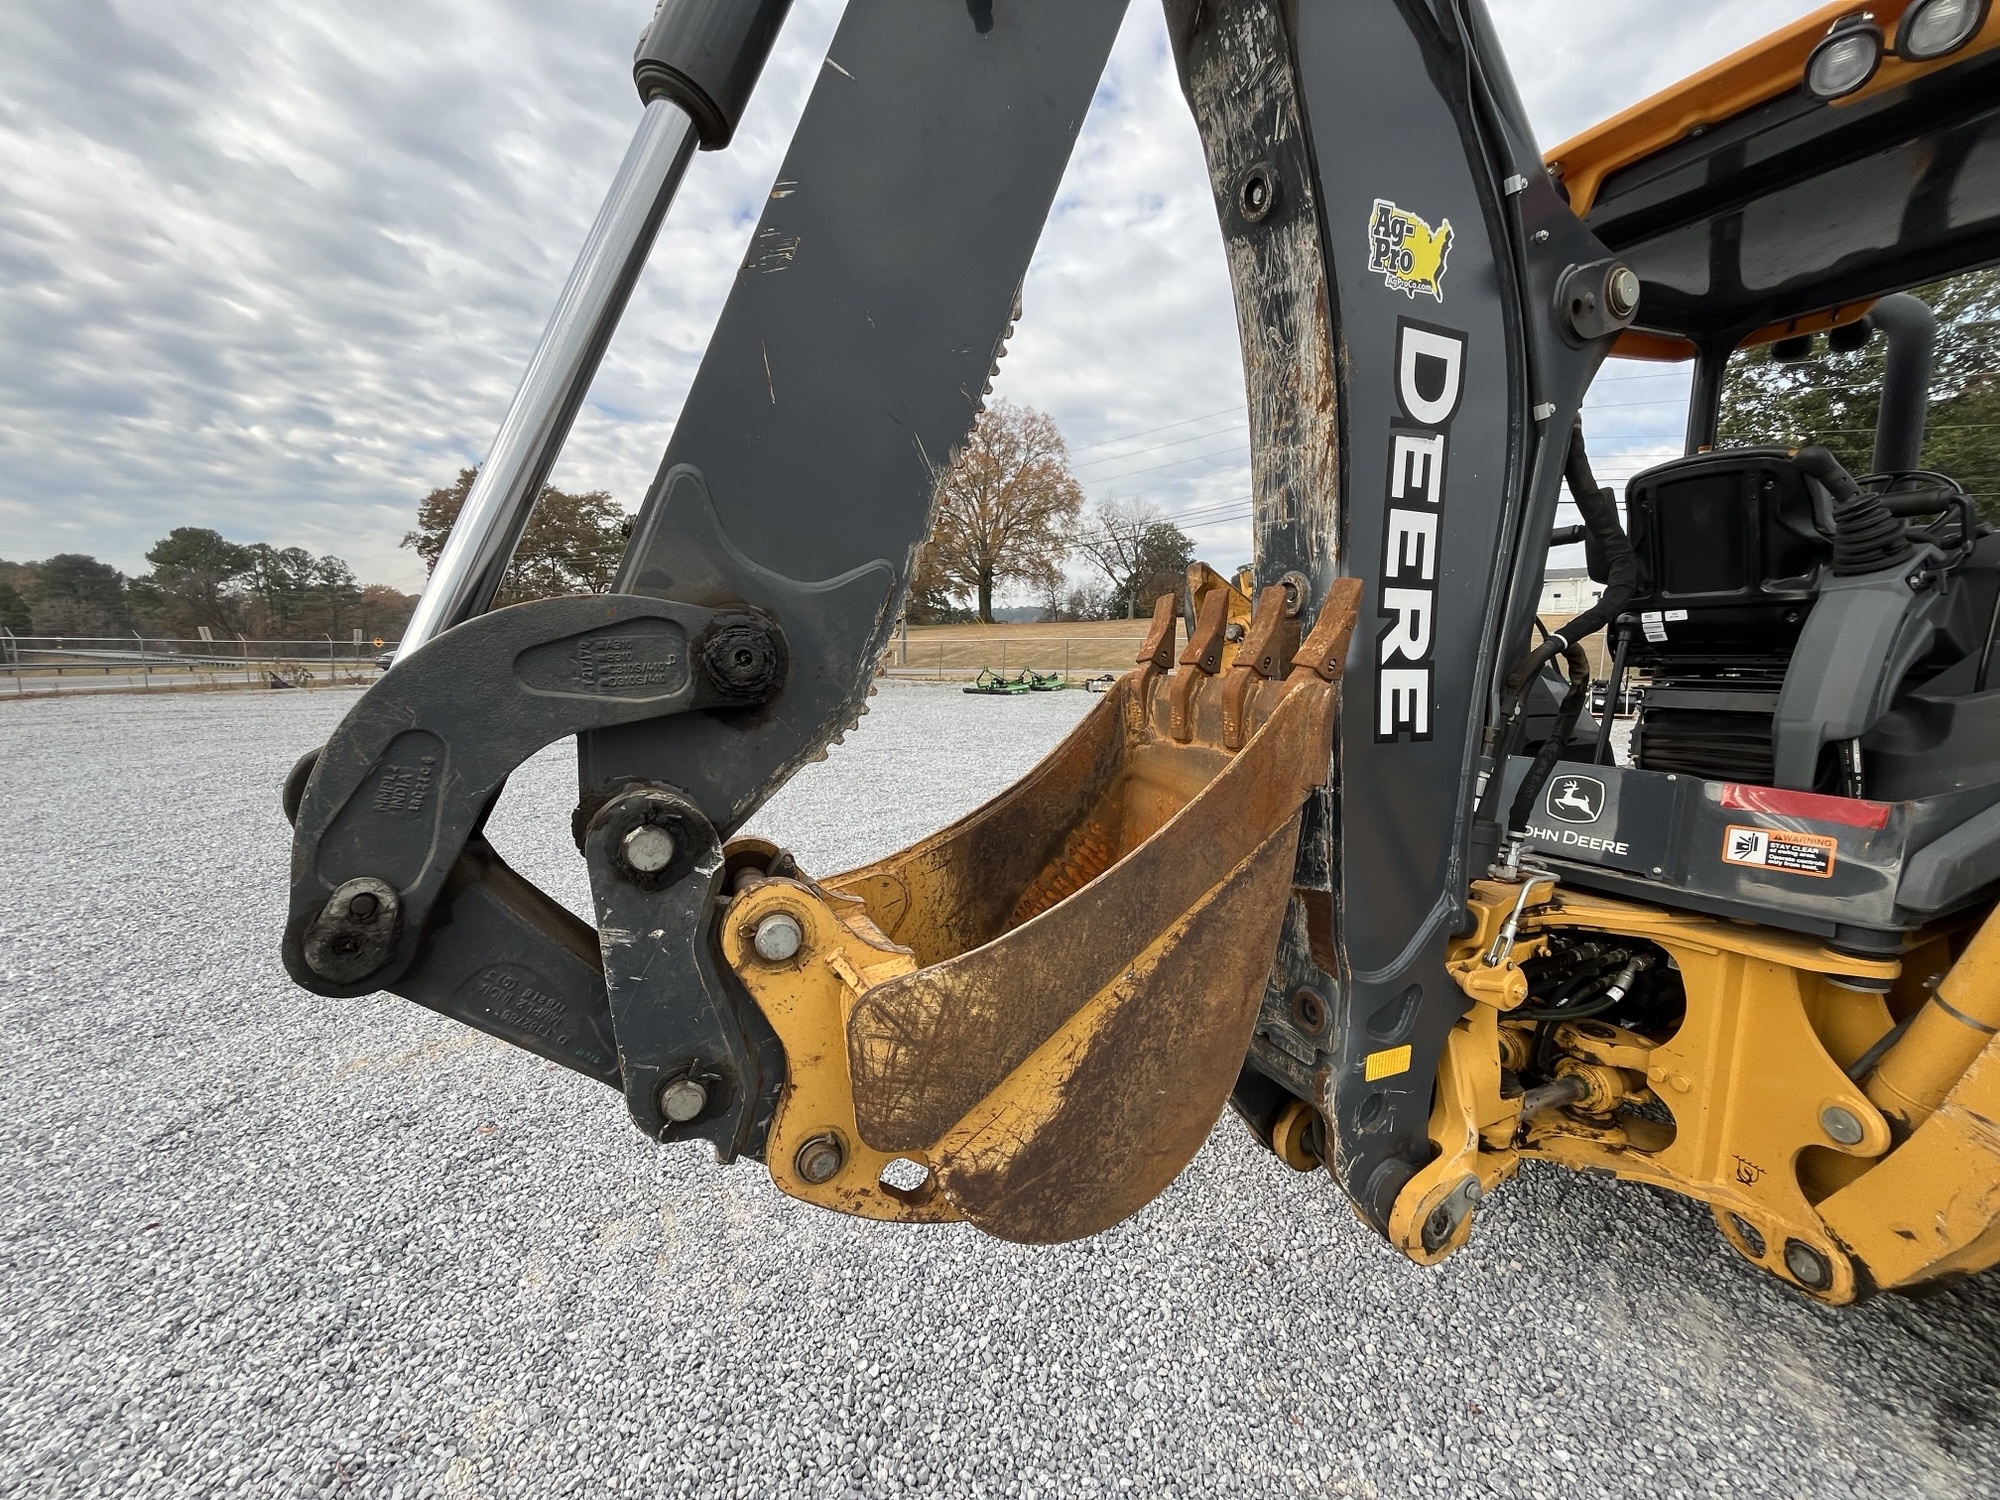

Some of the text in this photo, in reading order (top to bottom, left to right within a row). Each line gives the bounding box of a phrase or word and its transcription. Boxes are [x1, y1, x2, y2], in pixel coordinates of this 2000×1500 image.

[1373, 206, 1414, 246] Ag-
[1373, 239, 1413, 271] Pro
[1387, 276, 1432, 291] AgProCo.com
[1380, 326, 1462, 735] DEERE
[388, 774, 412, 809] INDIA
[1524, 825, 1630, 856] OHN DEERE
[1770, 842, 1819, 854] STAY CLEAR
[1784, 834, 1832, 848] WARNING
[1768, 853, 1826, 867] Operate controls
[1777, 849, 1799, 857] swing
[1784, 860, 1801, 868] from
